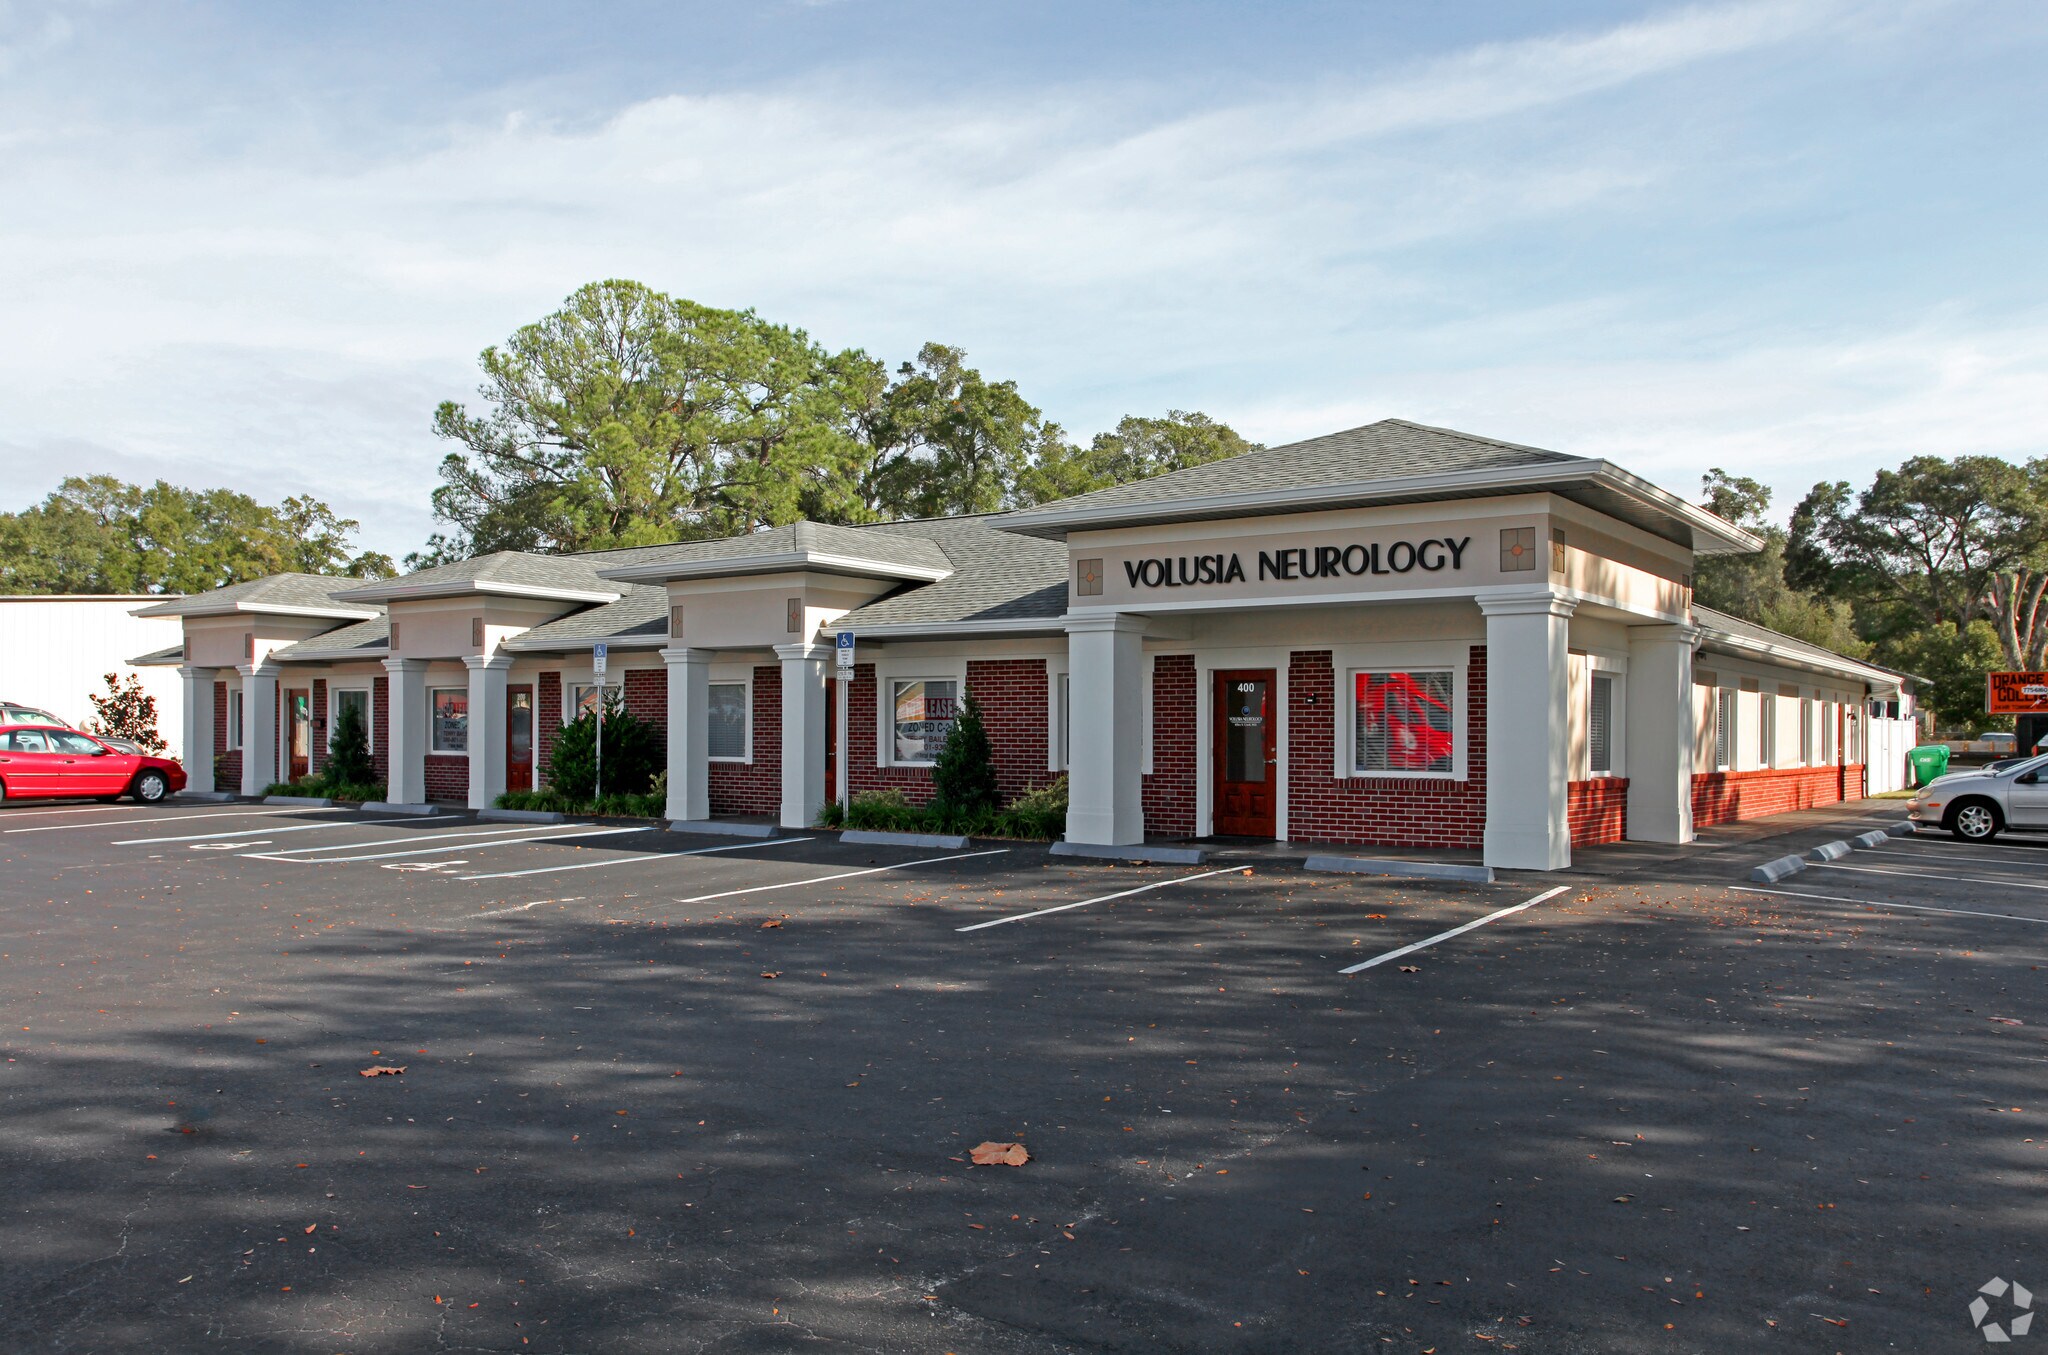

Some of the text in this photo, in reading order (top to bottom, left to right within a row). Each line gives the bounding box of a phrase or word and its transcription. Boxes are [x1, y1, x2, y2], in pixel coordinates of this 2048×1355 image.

[1123, 536, 1471, 589] VOLUSIA NEUROLOGY
[1237, 682, 1255, 692] 400
[925, 699, 953, 718] LEASE
[928, 735, 948, 743] BAILE
